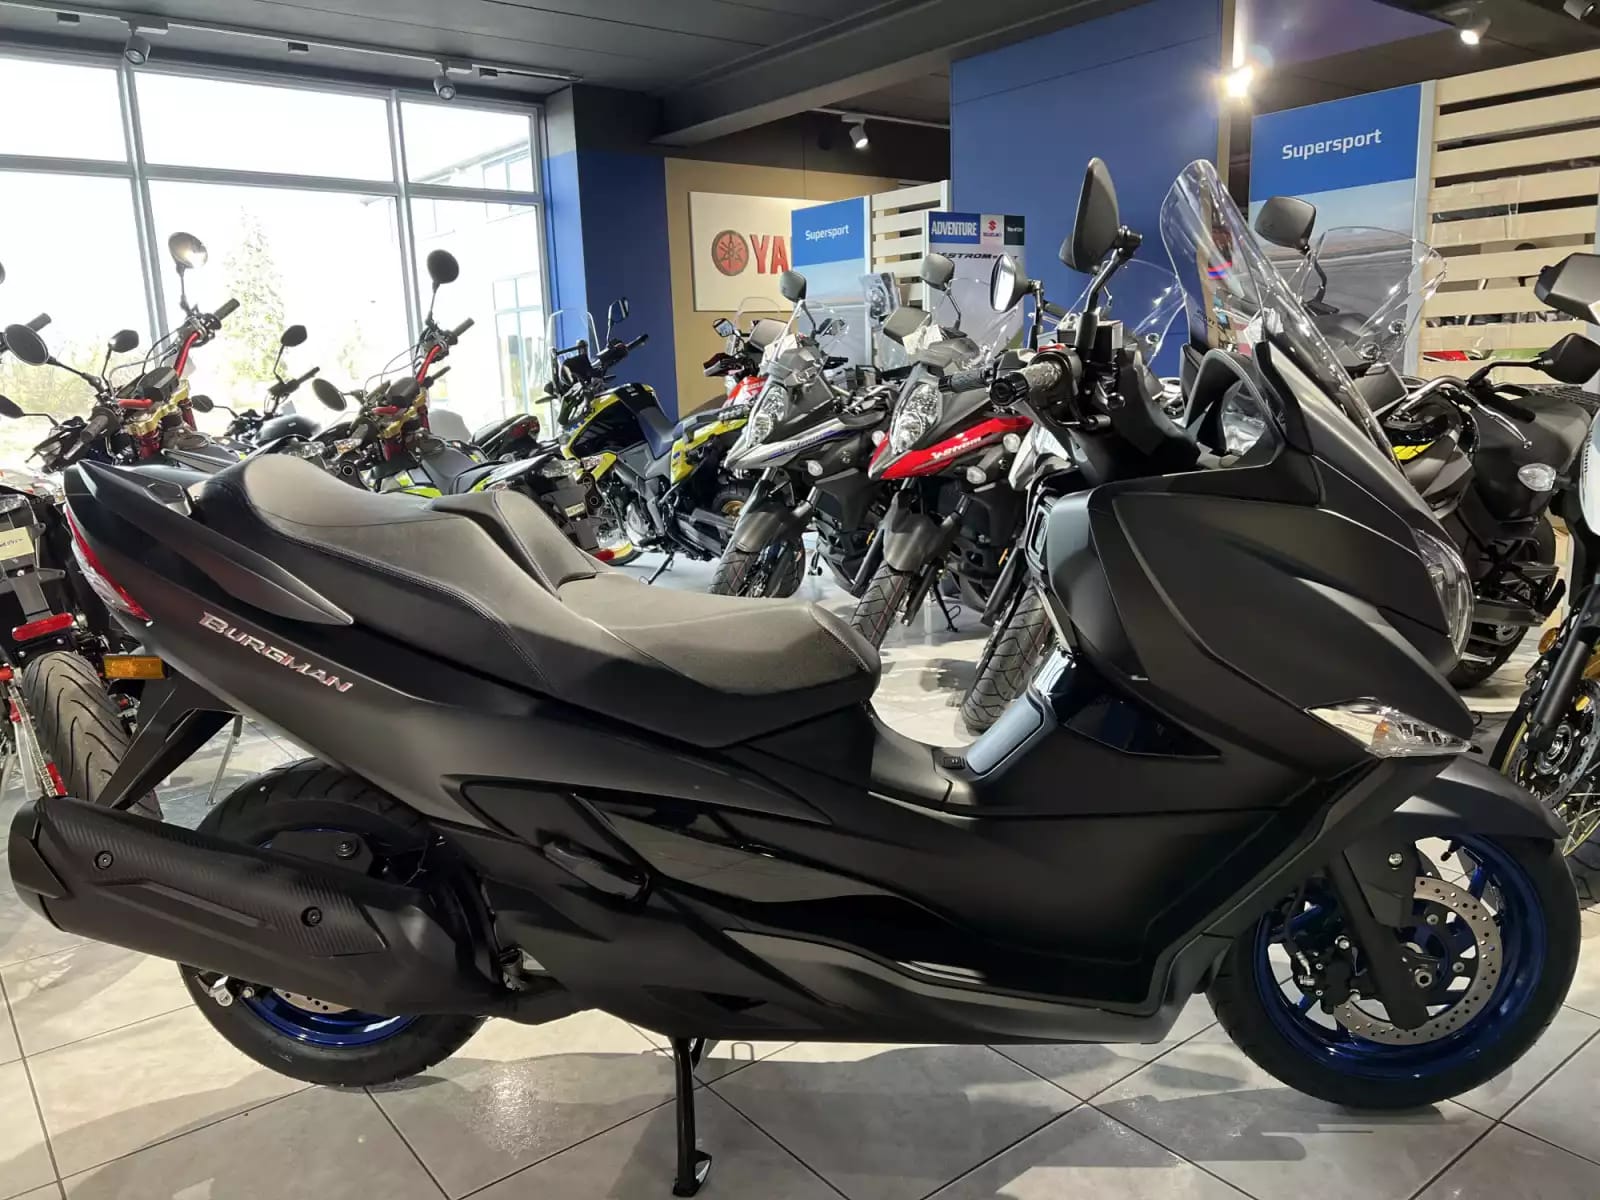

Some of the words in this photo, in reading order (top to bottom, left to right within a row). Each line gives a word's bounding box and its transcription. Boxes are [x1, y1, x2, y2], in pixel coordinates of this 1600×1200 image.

[1282, 129, 1382, 160] Supersport
[805, 224, 850, 241] Supersport
[931, 221, 978, 236] ADVENTURE
